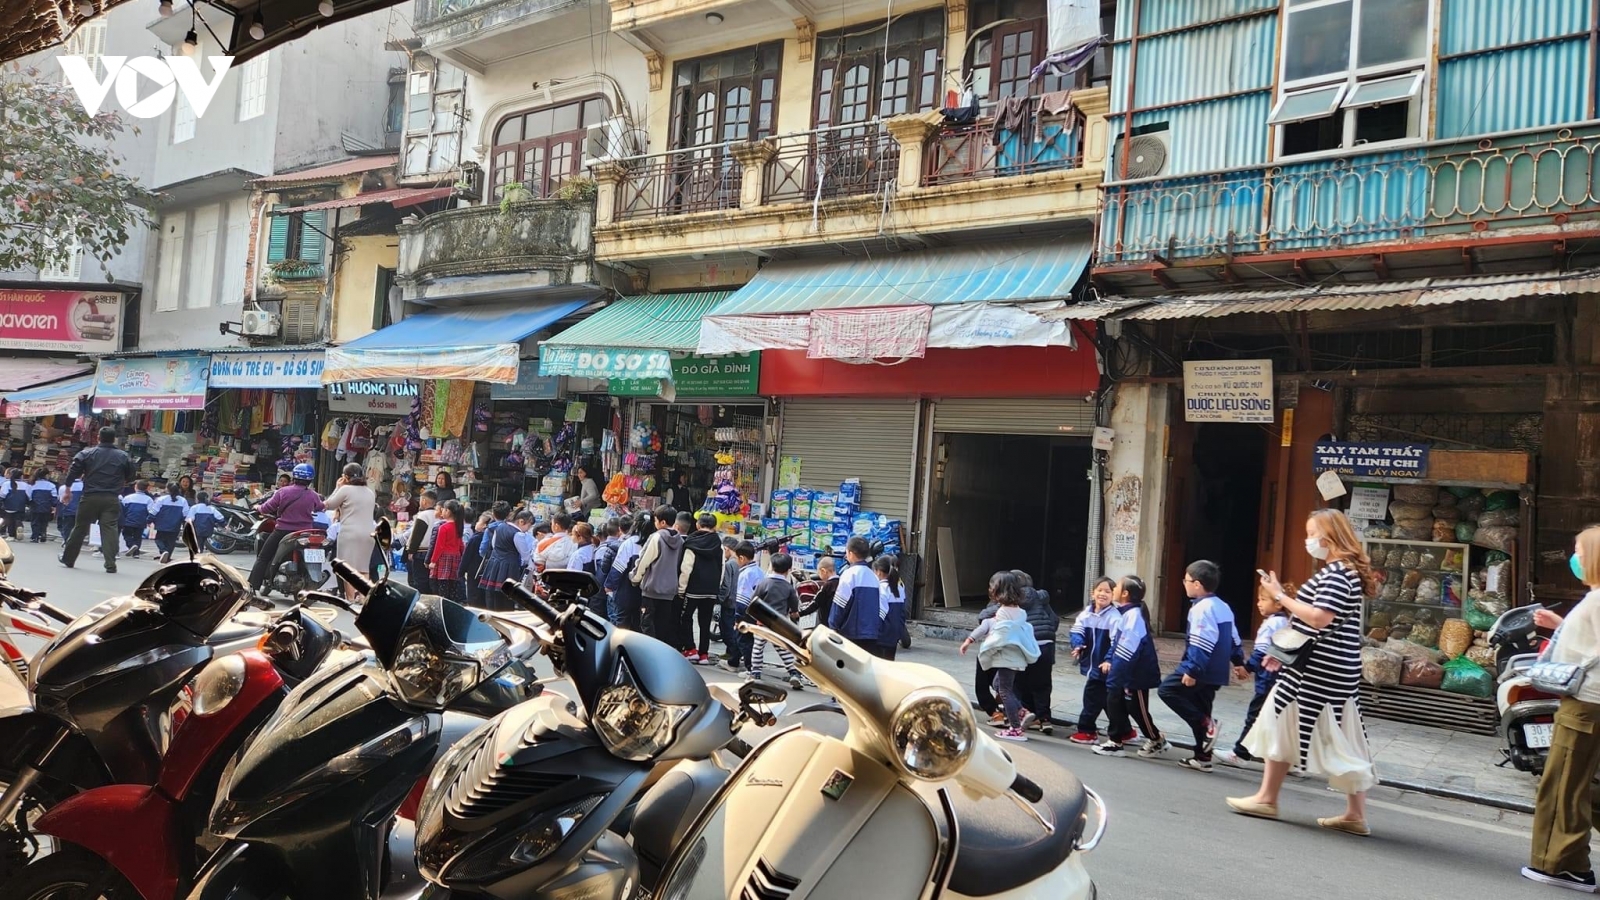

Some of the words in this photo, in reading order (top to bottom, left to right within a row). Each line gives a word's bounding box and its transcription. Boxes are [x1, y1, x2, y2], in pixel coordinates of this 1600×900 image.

[7, 292, 24, 302] HÀN
[24, 293, 46, 303] QUỐC
[0, 313, 58, 330] avoren
[262, 360, 274, 376] EM
[700, 366, 720, 374] GIA
[724, 363, 751, 373] ĐÌNH
[330, 382, 343, 394] 11
[348, 380, 386, 395] HƯƠNG
[1216, 399, 1238, 412] LIỆU
[1241, 398, 1271, 410] SỐNG
[1316, 446, 1346, 454] XAY
[1349, 447, 1379, 455] TAM
[1382, 446, 1422, 456] THẤT
[1320, 455, 1354, 465] THÁI
[1357, 458, 1390, 466] LINH
[1393, 460, 1419, 468] CHI
[1368, 468, 1388, 476] LẤY
